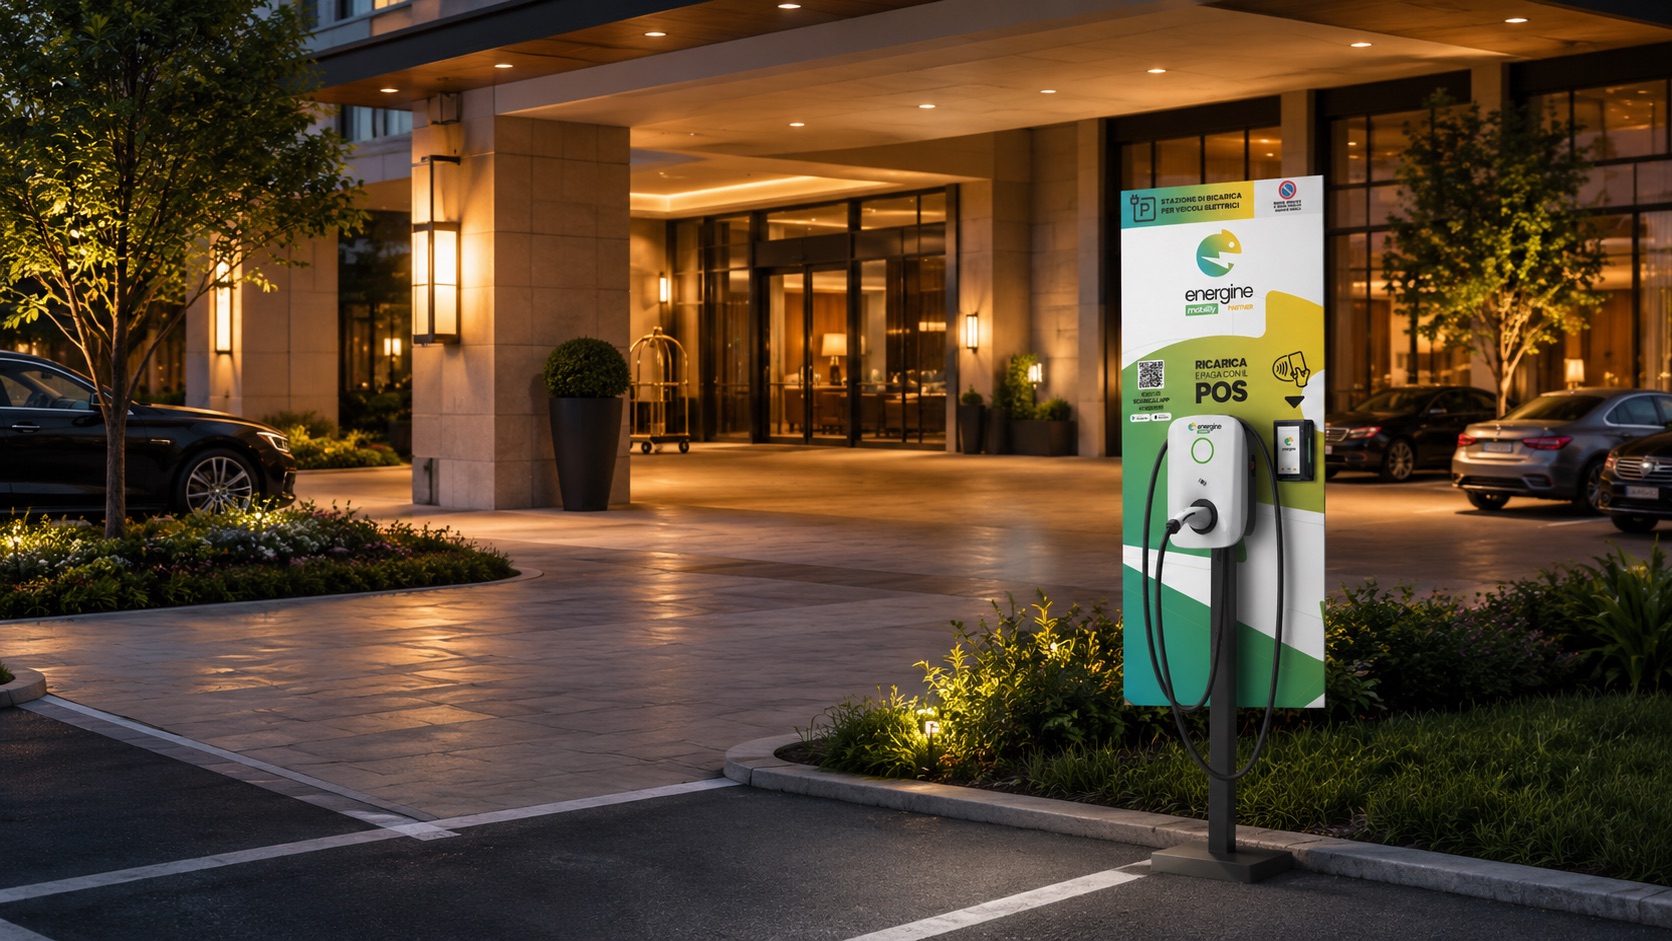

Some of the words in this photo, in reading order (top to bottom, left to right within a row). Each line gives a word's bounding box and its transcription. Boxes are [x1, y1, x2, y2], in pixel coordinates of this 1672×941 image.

[1161, 196, 1196, 204] STAZIONE
[1204, 202, 1240, 210] ELETTRICI
[1140, 202, 1150, 216] P
[1185, 284, 1253, 304] energine
[1196, 358, 1248, 370] RICARICA
[1200, 371, 1222, 379] PAGA
[1196, 380, 1248, 404] POS
